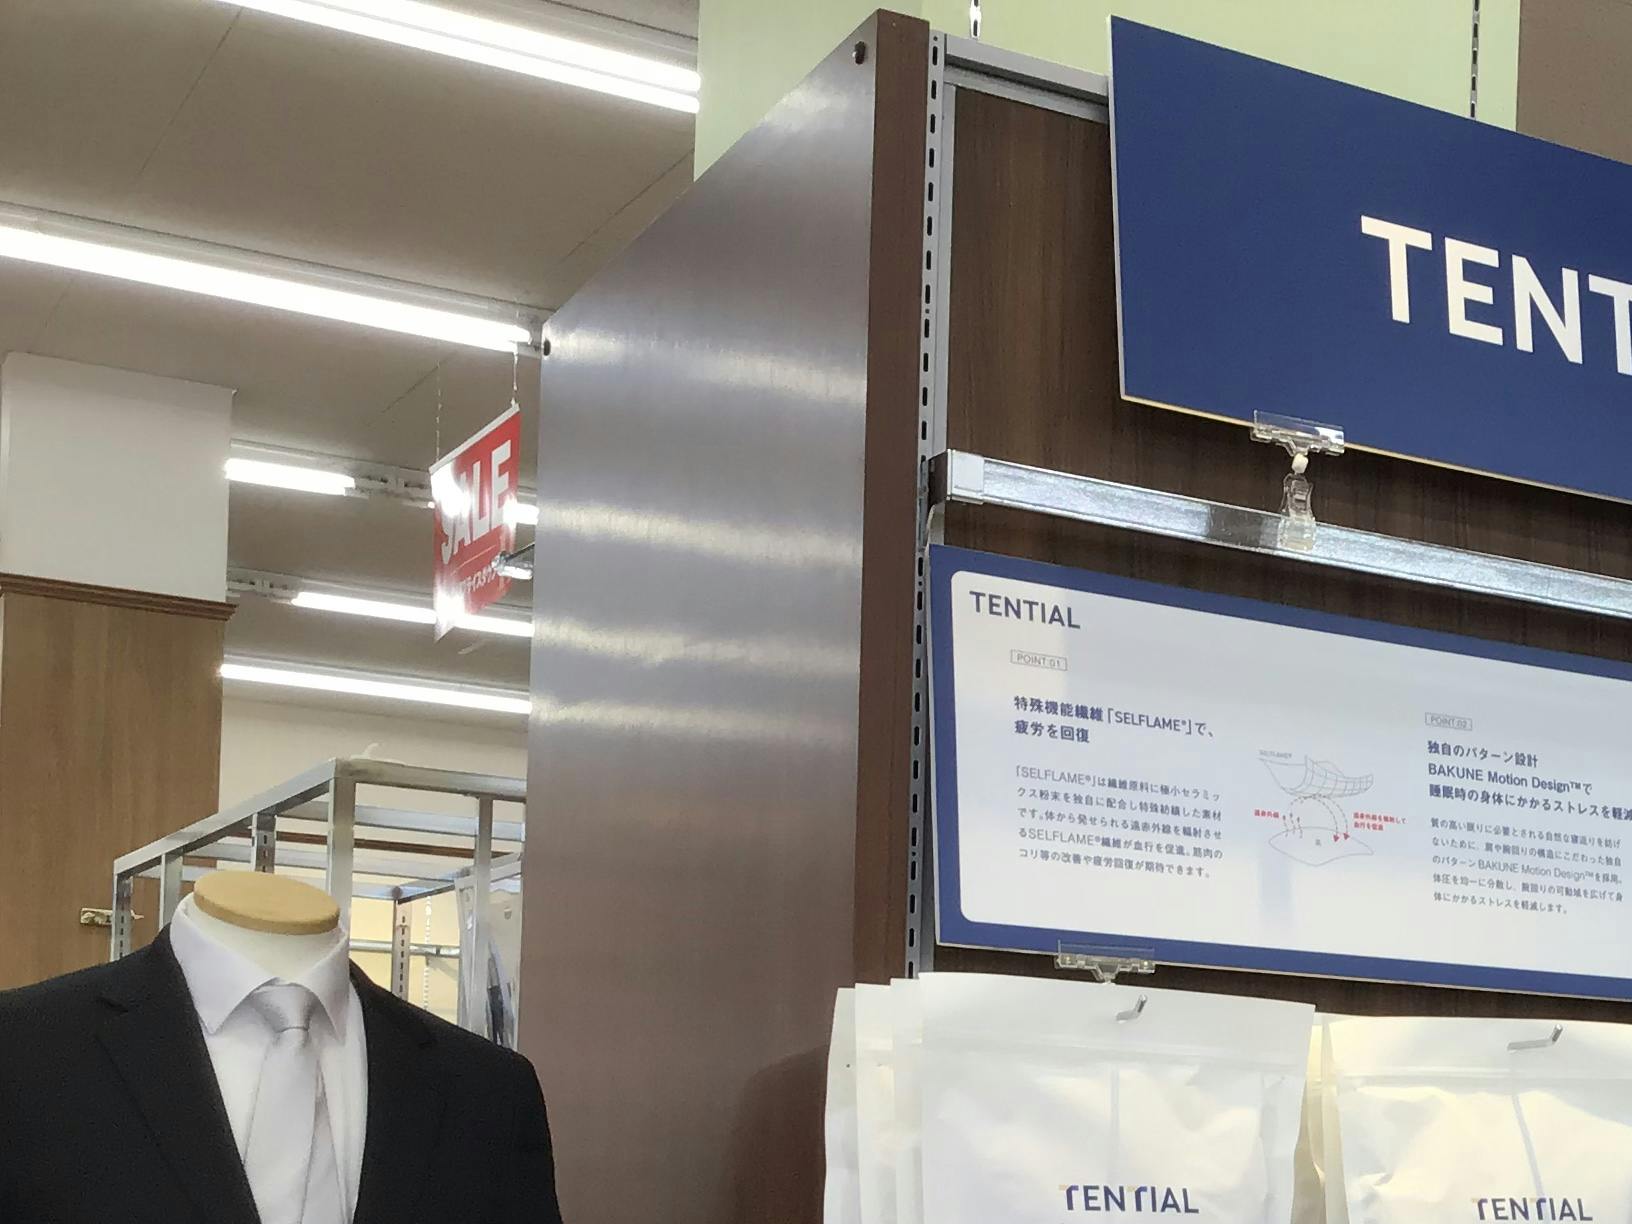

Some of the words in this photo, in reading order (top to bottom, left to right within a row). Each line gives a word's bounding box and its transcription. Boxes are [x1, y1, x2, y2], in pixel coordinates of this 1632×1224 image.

[969, 590, 1081, 629] TENTIAL
[1014, 720, 1090, 743] 疲労を回復
[1428, 740, 1538, 768] 独自のパターン設計
[1428, 763, 1483, 782] BAKUNE
[1488, 771, 1527, 787] Motion
[1532, 776, 1592, 795] Design™で
[1478, 859, 1519, 874] BAKUNE
[1521, 864, 1551, 877] Motion
[1059, 1184, 1199, 1214] TENTIAL
[1471, 1197, 1593, 1221] TENTIAL
